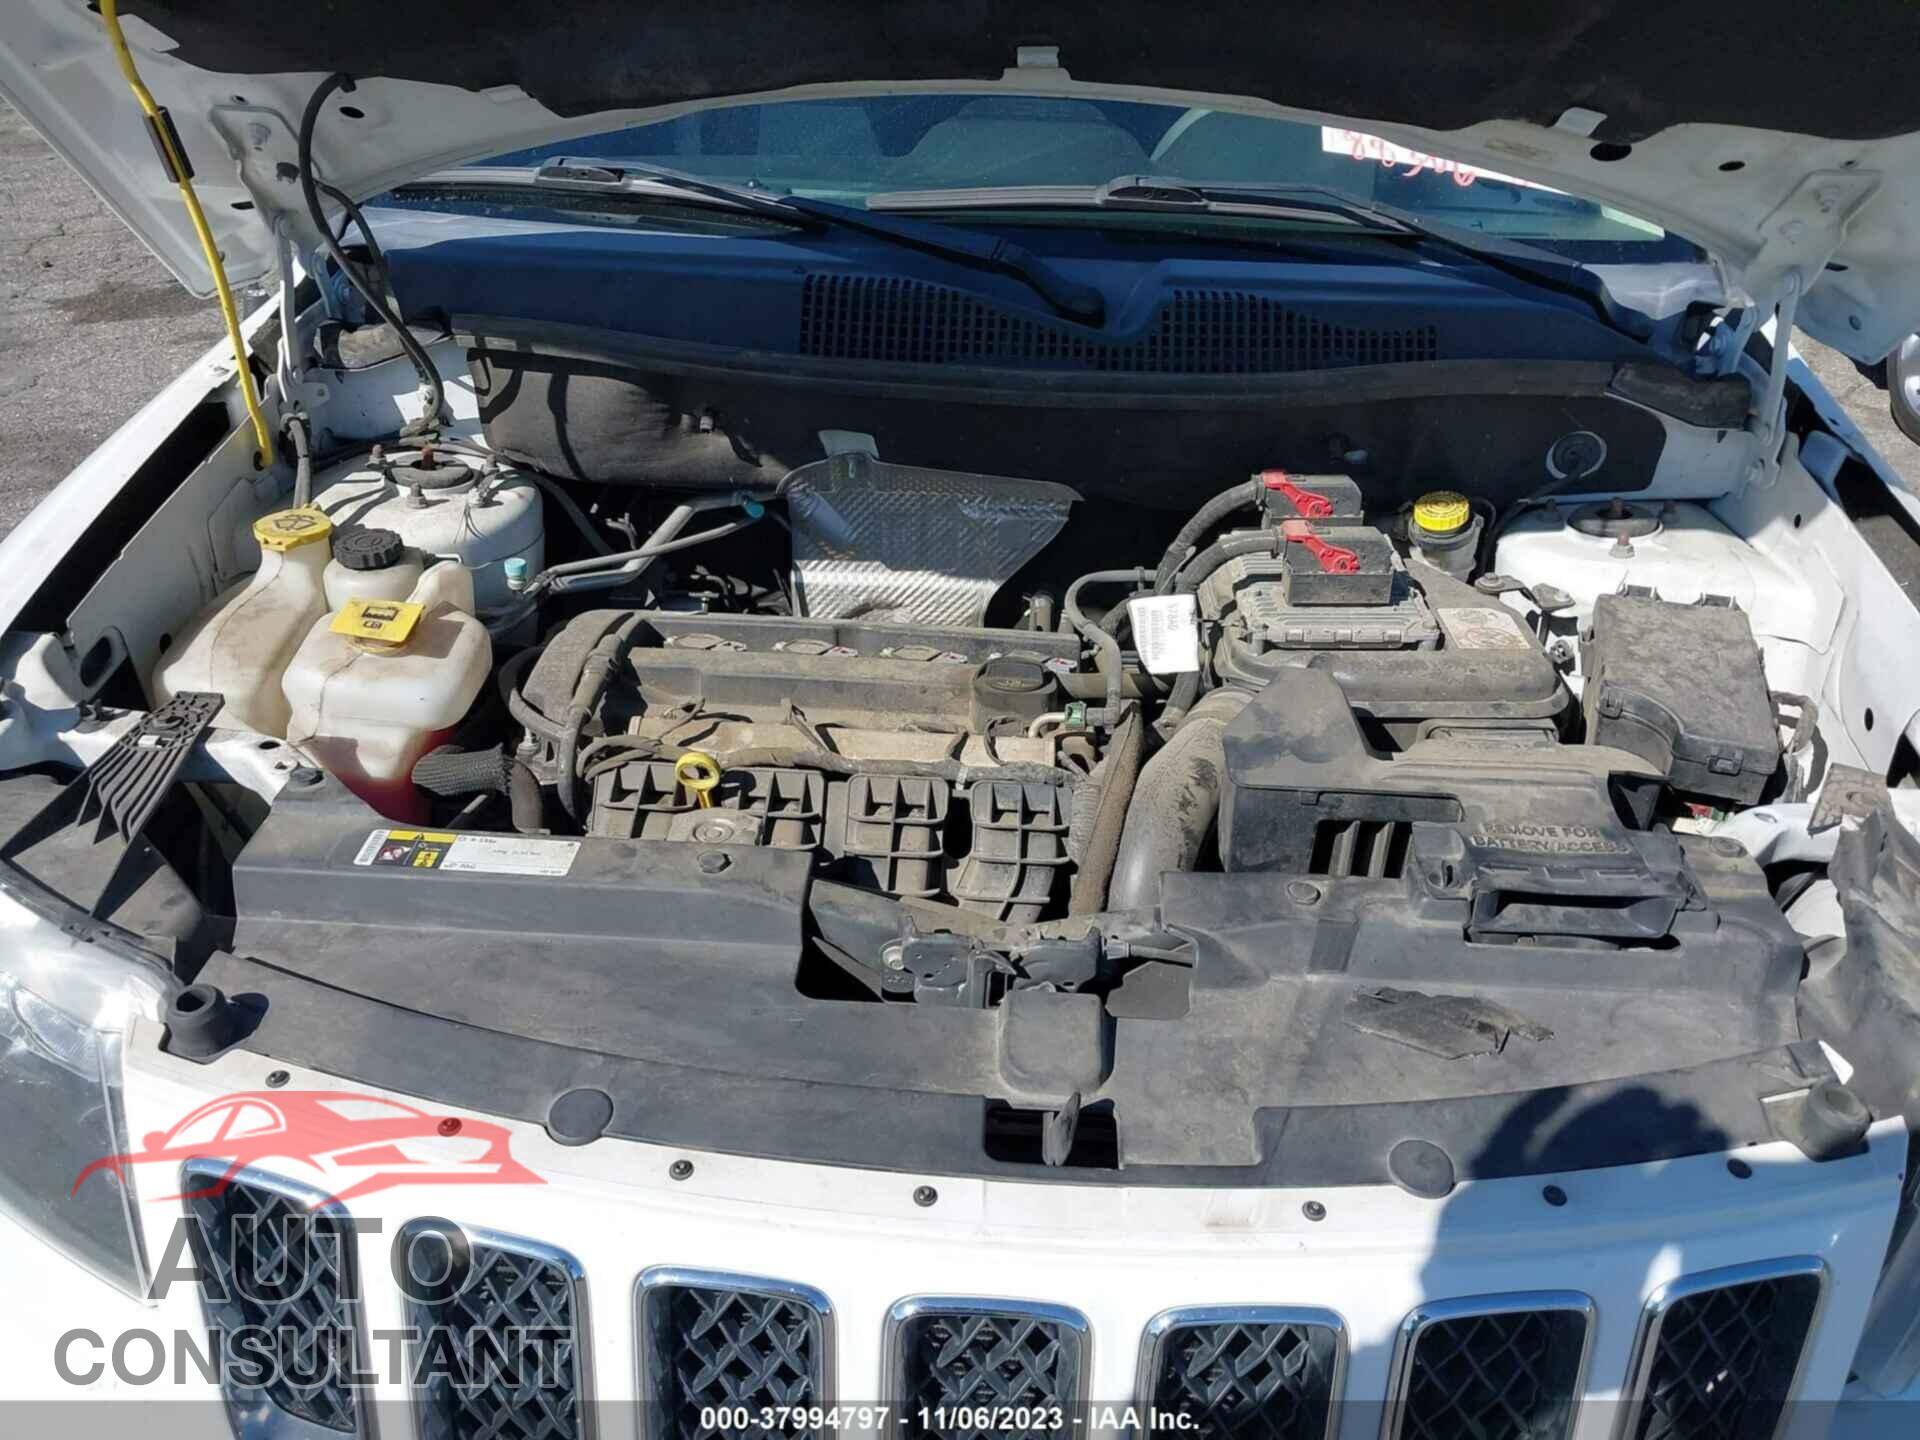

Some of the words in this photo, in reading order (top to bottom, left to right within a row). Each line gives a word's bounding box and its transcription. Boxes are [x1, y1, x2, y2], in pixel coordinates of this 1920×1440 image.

[1484, 823, 1559, 838] REMOVE
[1562, 824, 1601, 839] FOR
[1472, 833, 1549, 850] BATTERY
